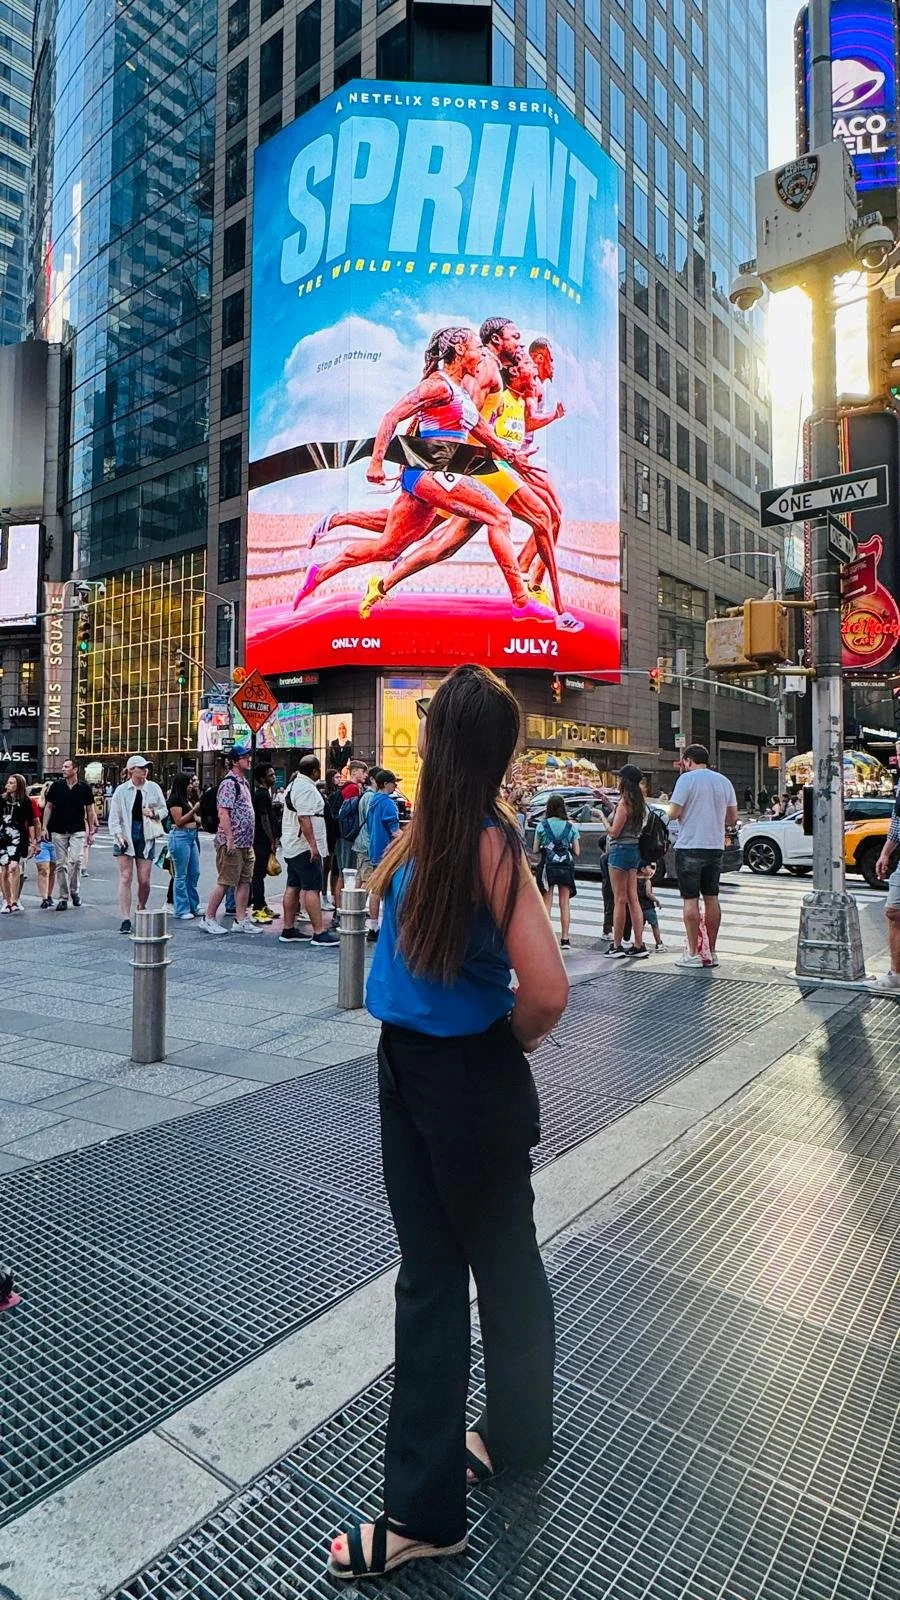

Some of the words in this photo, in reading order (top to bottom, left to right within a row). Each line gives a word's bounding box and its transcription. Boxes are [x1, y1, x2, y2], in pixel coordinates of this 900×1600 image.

[334, 101, 343, 114] A
[349, 92, 423, 106] NETFLIX
[431, 96, 499, 110] SPORTS
[507, 101, 560, 125] SERIES
[832, 114, 887, 138] ACO
[841, 134, 888, 156] ELL
[280, 115, 598, 285] SPRINT
[298, 275, 323, 298] THE
[332, 258, 416, 279] WORLD'S
[428, 263, 518, 278] FASTEST
[530, 267, 583, 304] HUMANS
[334, 354, 342, 366] at
[343, 350, 382, 363] nothing!
[443, 471, 456, 482] 6
[778, 493, 813, 514] ONE
[830, 481, 869, 504] WAY
[50, 596, 64, 666] SQUARE
[331, 637, 359, 650] ONLY
[361, 638, 380, 648] ON
[503, 637, 550, 654] JULY
[550, 640, 559, 656] 2
[48, 683, 62, 736] TIMES
[242, 701, 257, 710] WORK
[256, 702, 270, 712] ZONE
[47, 746, 61, 756] 3
